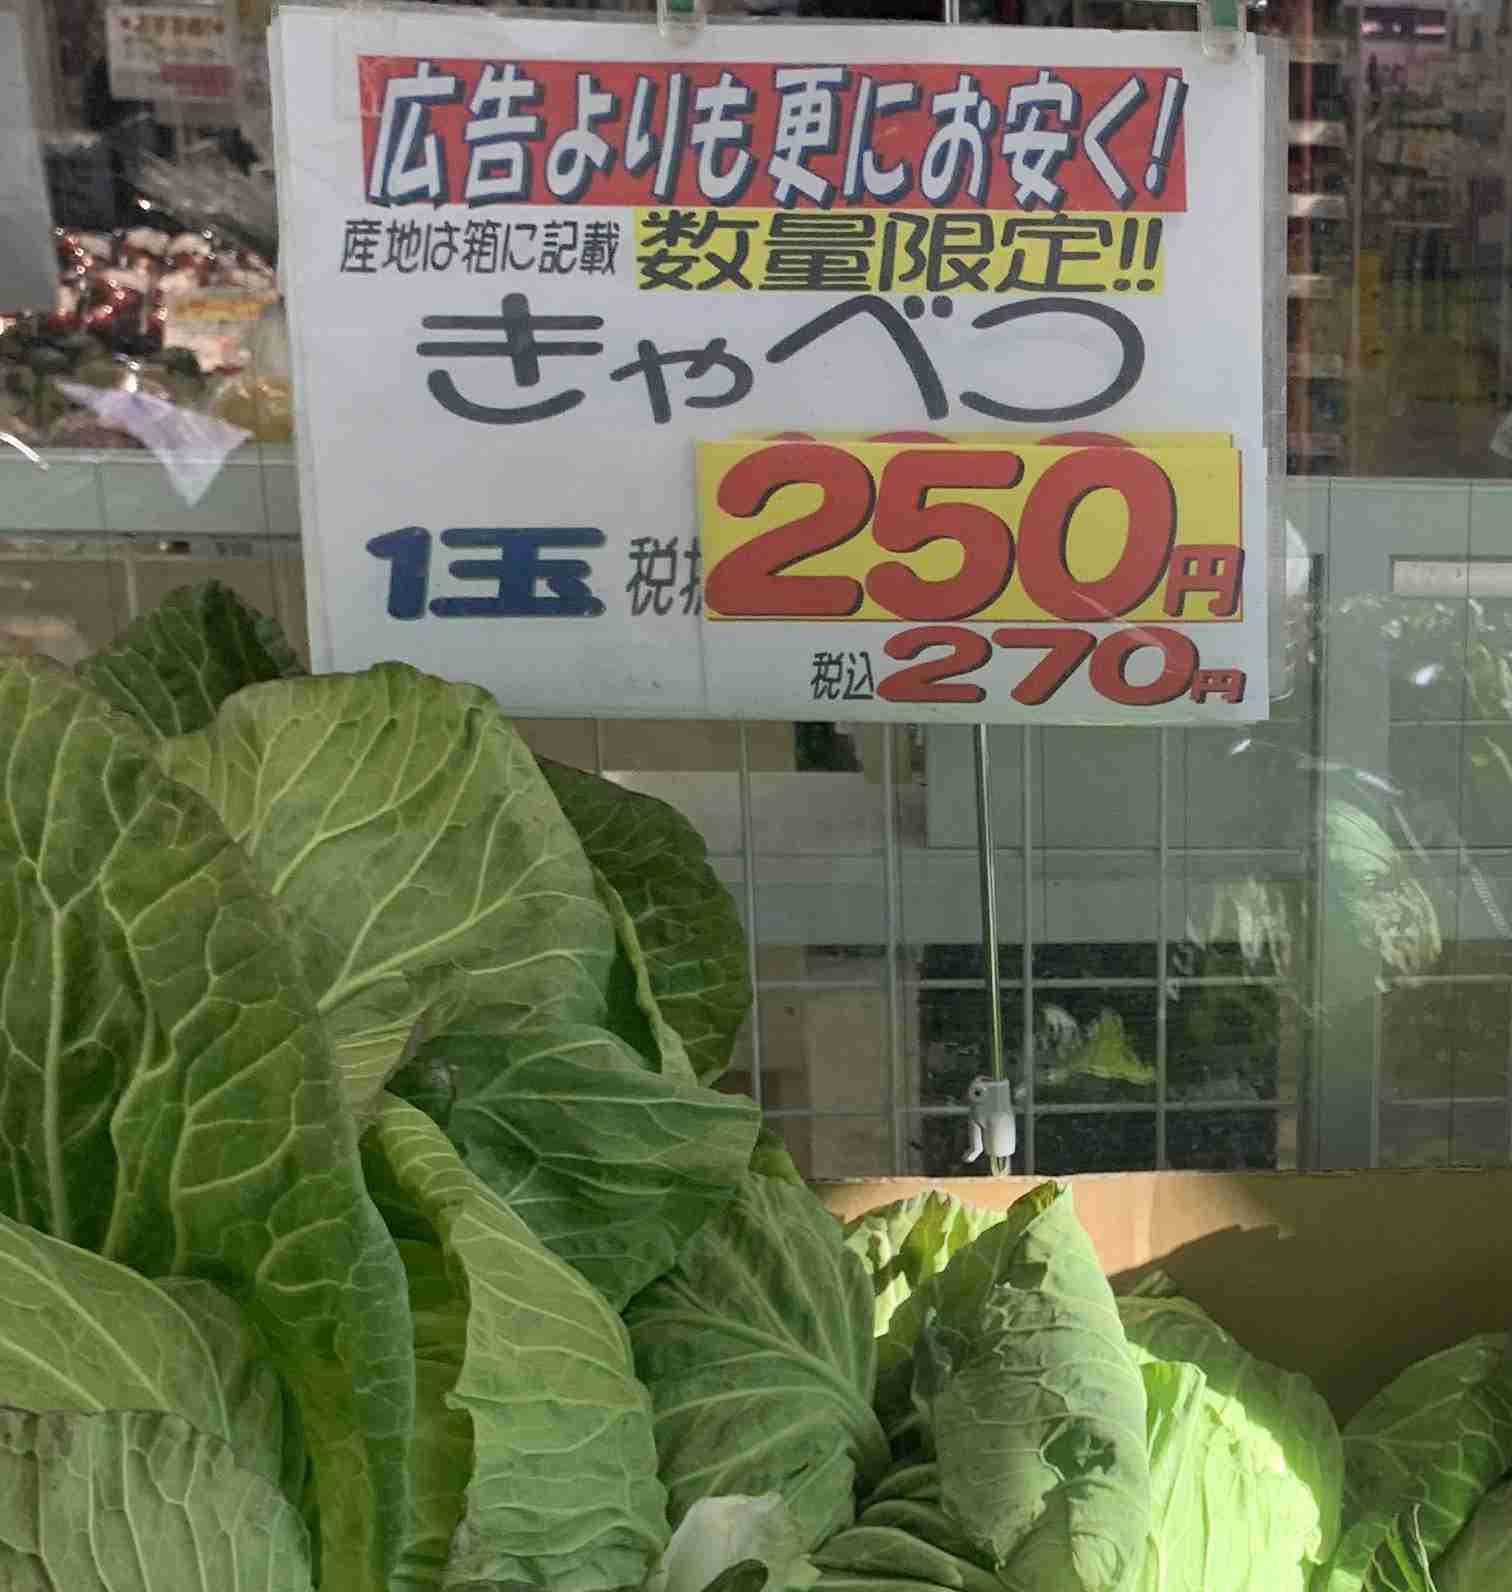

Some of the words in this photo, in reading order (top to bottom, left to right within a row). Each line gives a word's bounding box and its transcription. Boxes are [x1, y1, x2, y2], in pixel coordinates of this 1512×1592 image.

[368, 63, 1187, 209] 広告よりも更にお安く!
[339, 217, 619, 277] 産地は箱に記載
[634, 210, 1163, 294] 数量限定!!
[416, 292, 1146, 425] きゃべつ
[365, 524, 607, 620] 1玉
[704, 443, 1244, 622] 250円
[810, 651, 875, 701] 税込
[875, 625, 1247, 706] 270円
